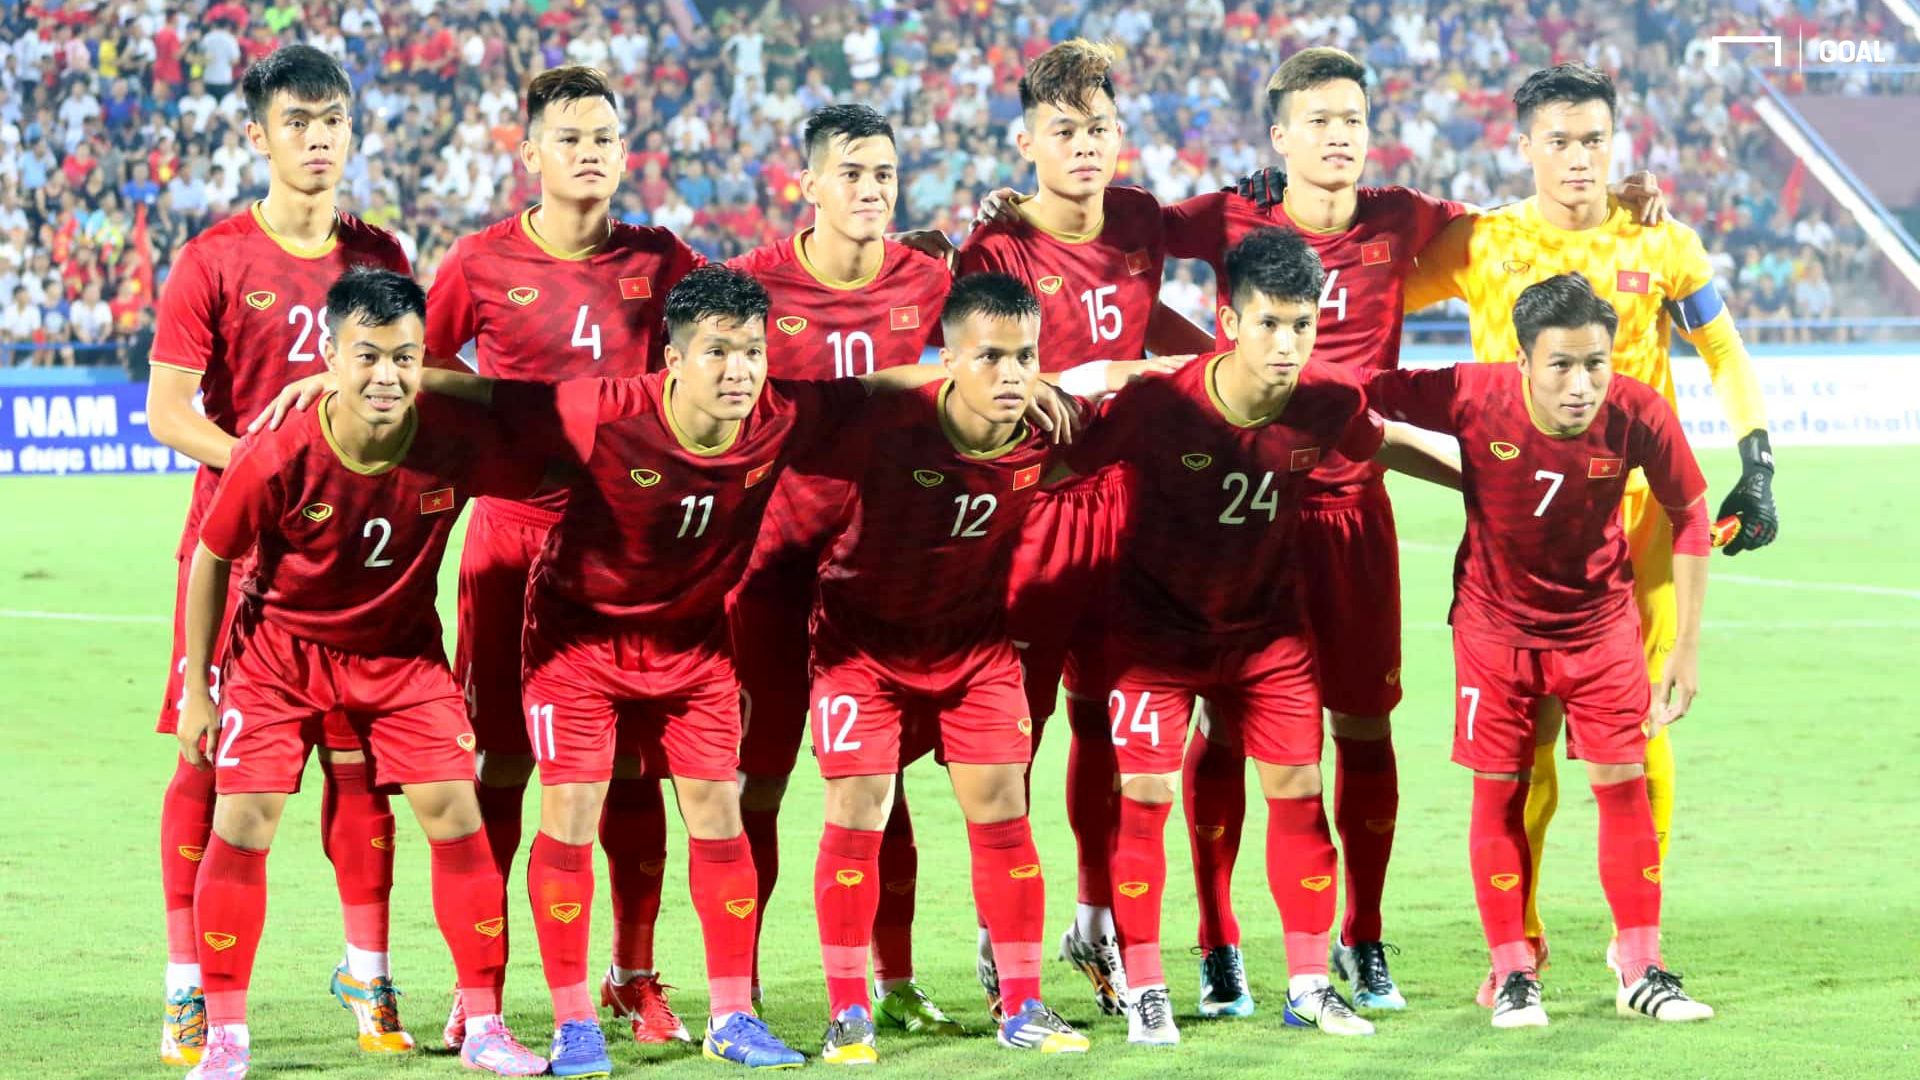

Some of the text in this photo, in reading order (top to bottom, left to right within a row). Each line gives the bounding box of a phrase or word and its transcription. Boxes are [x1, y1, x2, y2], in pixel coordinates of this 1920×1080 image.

[571, 305, 601, 360] 4
[1081, 285, 1122, 344] 15
[826, 331, 874, 379] 10
[14, 395, 118, 438] NAM
[676, 495, 714, 538] 11
[950, 493, 998, 538] 12
[1218, 471, 1278, 524] 24
[1533, 469, 1564, 517] 7
[363, 517, 394, 567] 2
[217, 708, 243, 767] 2
[530, 703, 556, 761] 11
[818, 694, 861, 753] 12
[1108, 689, 1160, 746] 24
[1461, 686, 1480, 741] 7
